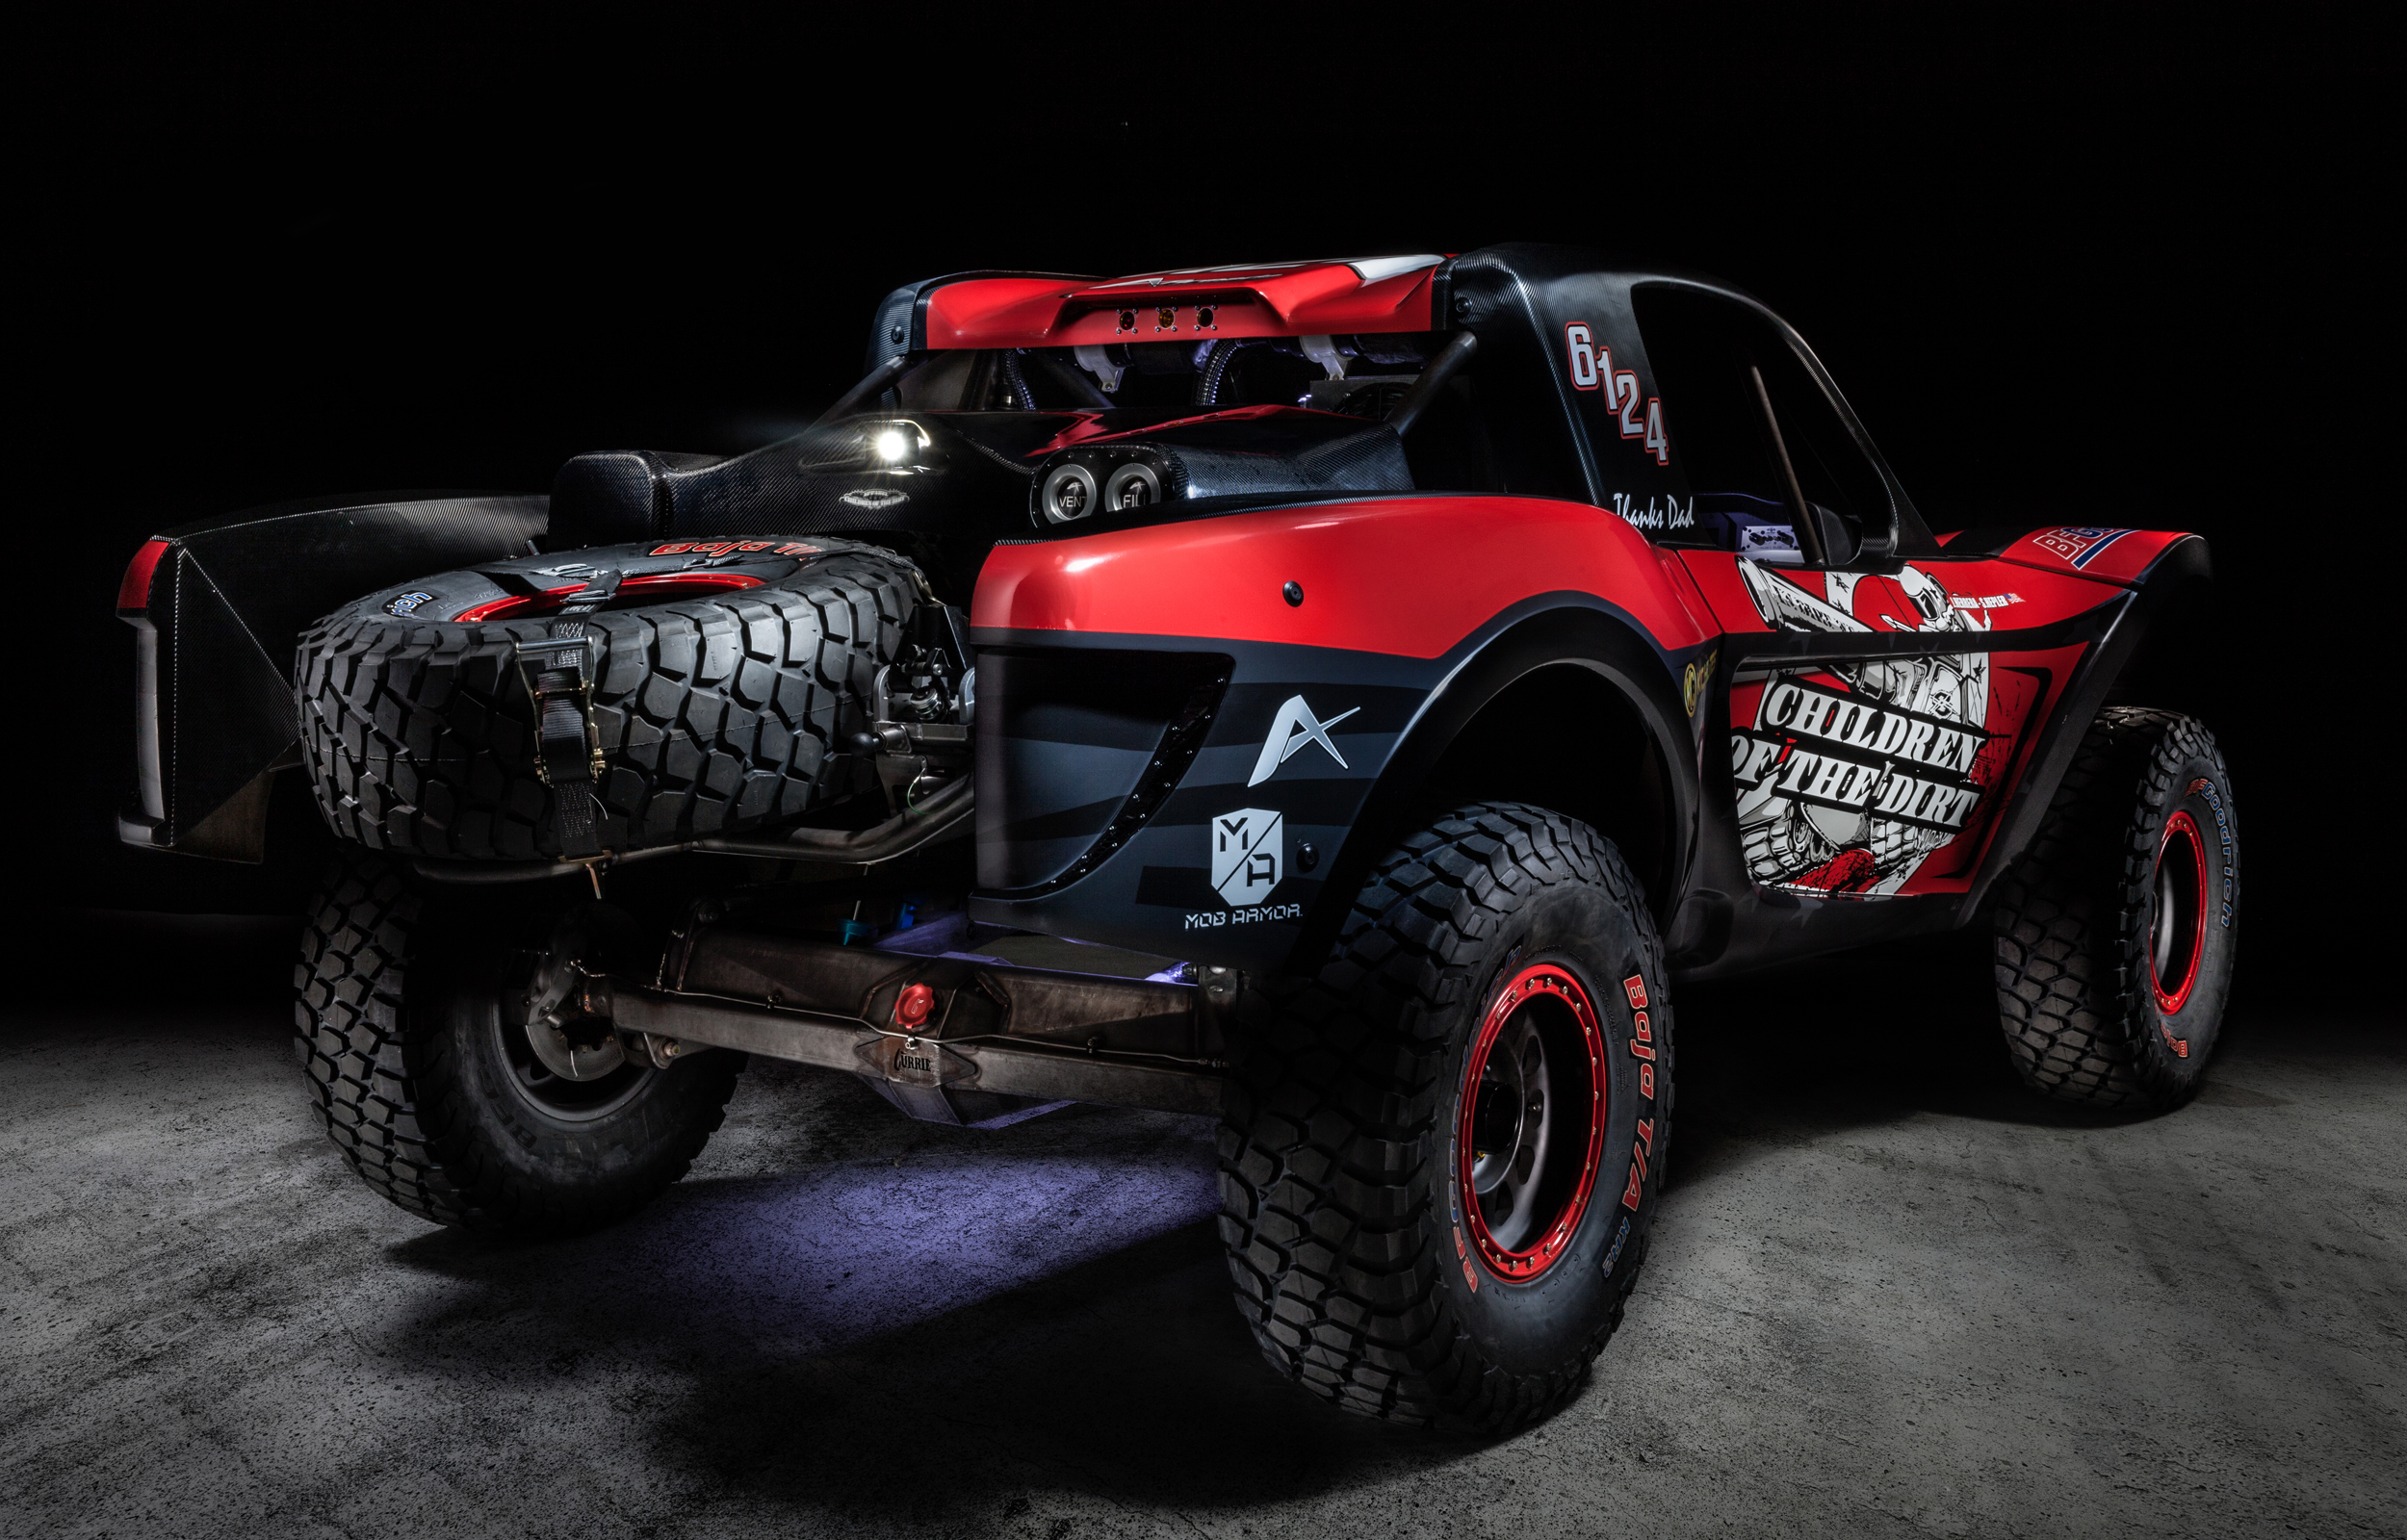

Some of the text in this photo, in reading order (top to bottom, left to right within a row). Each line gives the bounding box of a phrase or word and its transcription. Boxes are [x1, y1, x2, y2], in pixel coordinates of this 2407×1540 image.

[1566, 321, 1669, 466] 6124
[1059, 496, 1088, 508] VENT
[1614, 493, 1695, 529] Thanks Dad
[649, 540, 774, 557] Baja
[1766, 683, 1985, 773] CHILDREN
[1732, 734, 1980, 828] OF THE DIRT
[2185, 778, 2232, 928] BFGoodrich
[1185, 911, 1227, 930] MOB
[893, 1048, 931, 1072] CURRIE
[1623, 974, 1656, 1100] Baja
[1622, 1117, 1654, 1213] T/A
